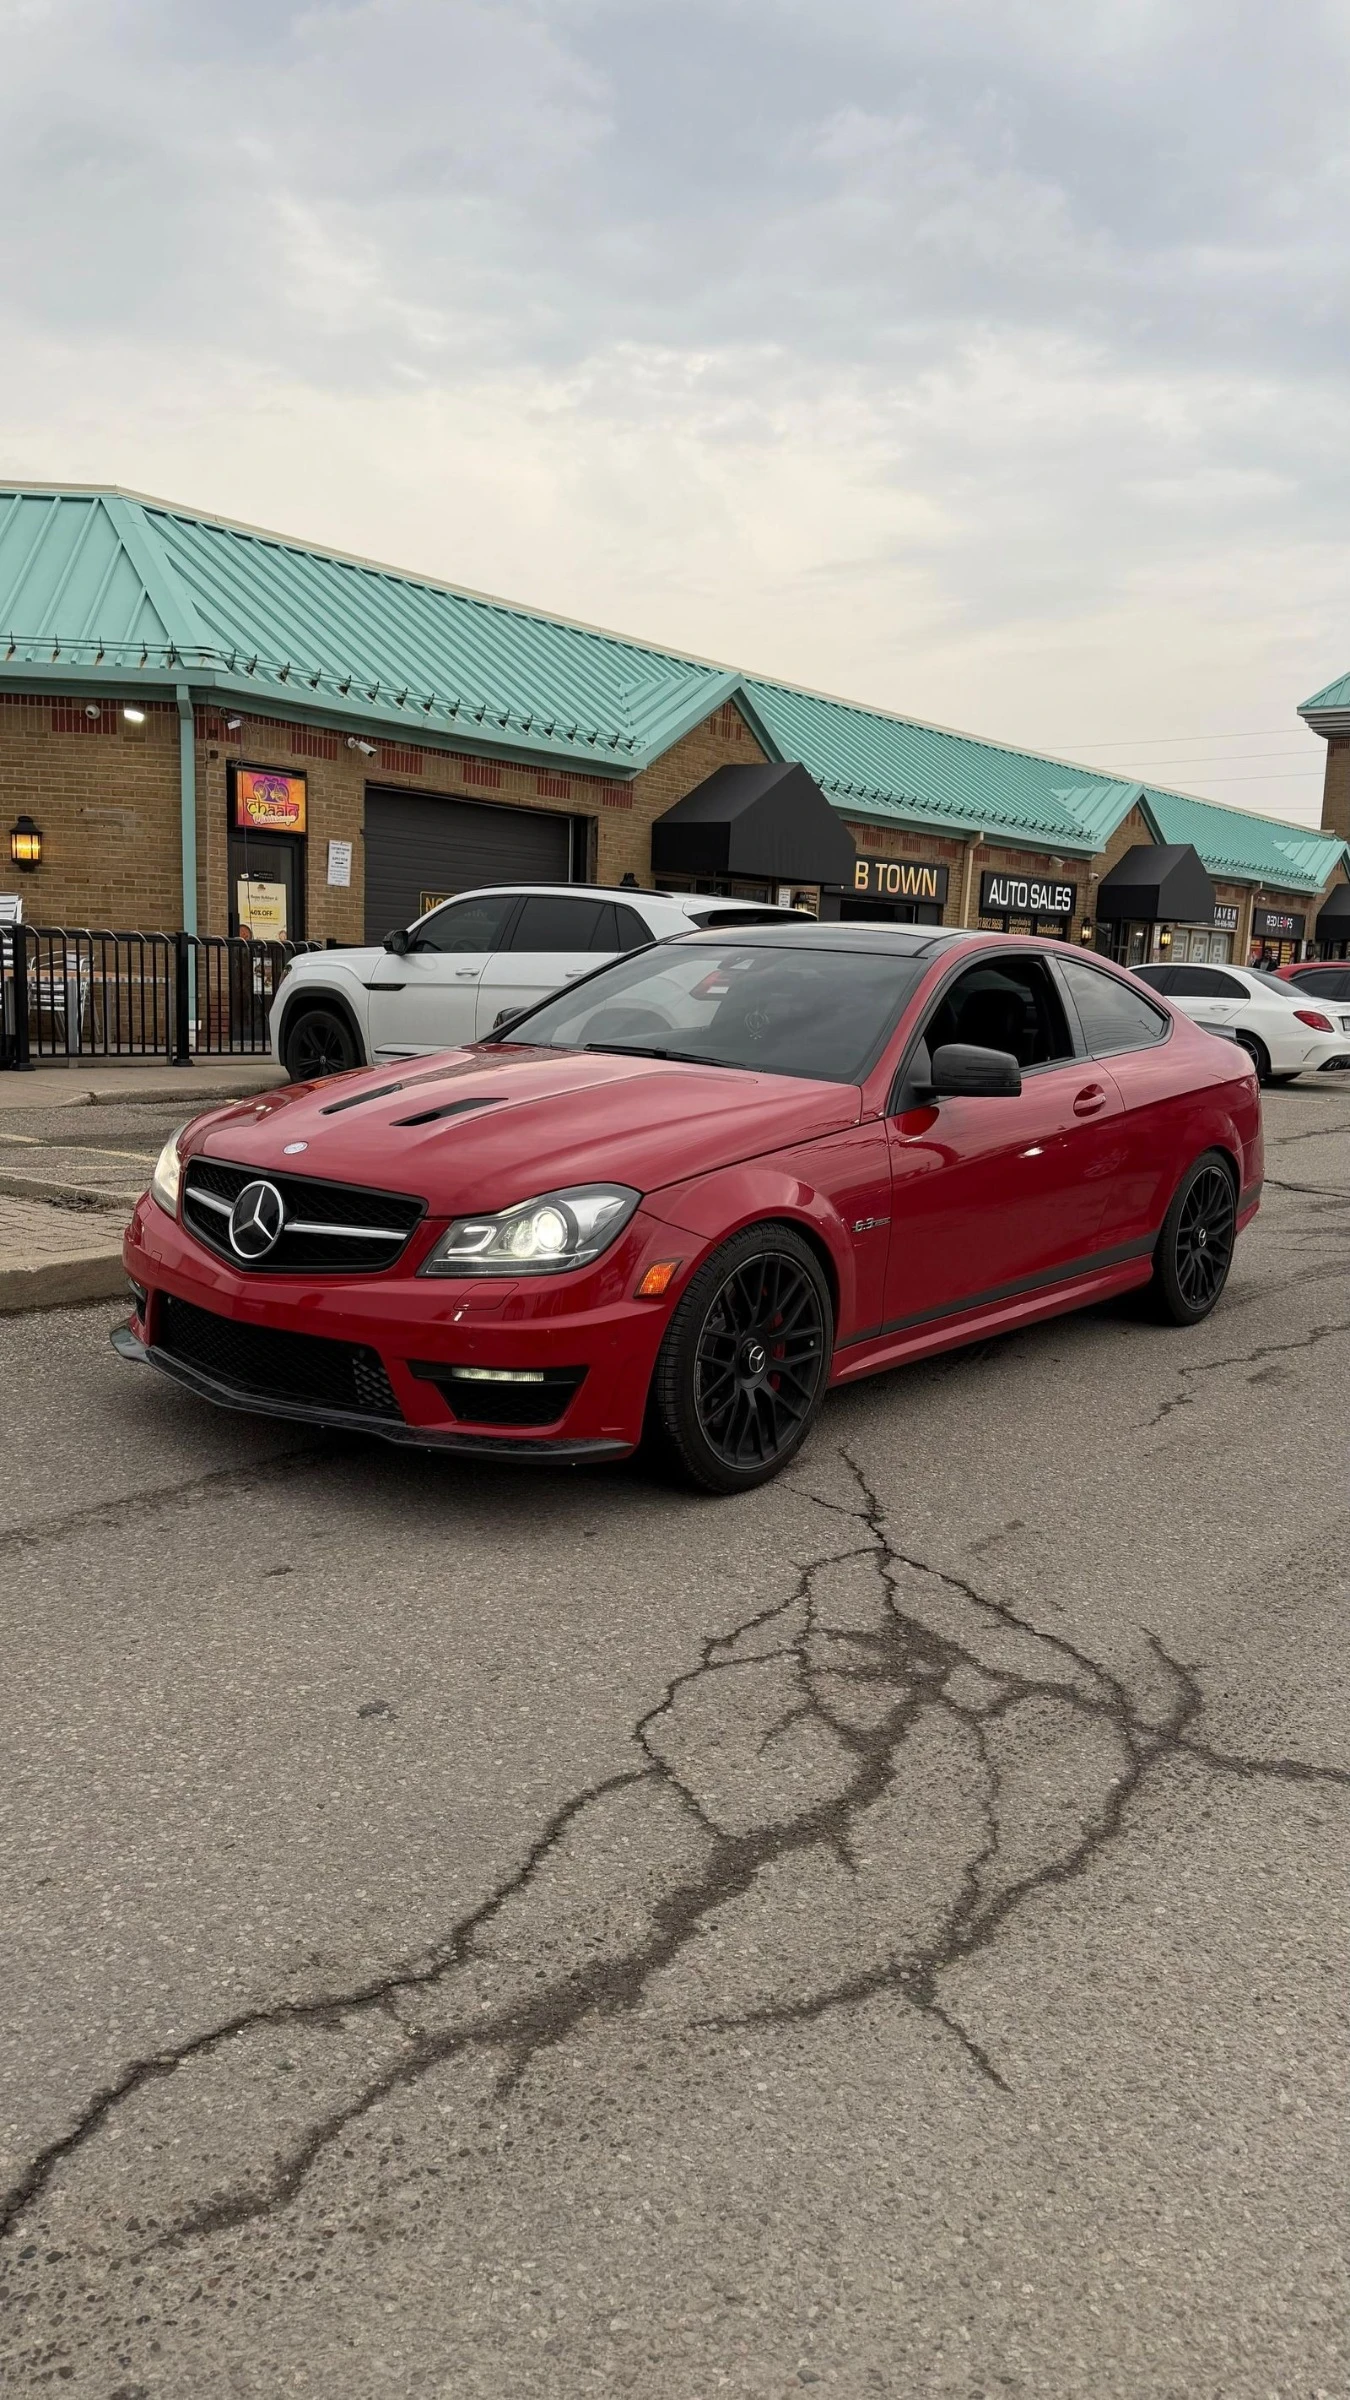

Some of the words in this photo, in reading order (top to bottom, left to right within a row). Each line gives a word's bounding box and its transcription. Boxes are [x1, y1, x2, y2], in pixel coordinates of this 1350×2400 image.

[854, 861, 869, 890] B
[875, 863, 938, 897] TOWN
[988, 878, 1028, 908] AUTO
[1030, 883, 1072, 911] SALES
